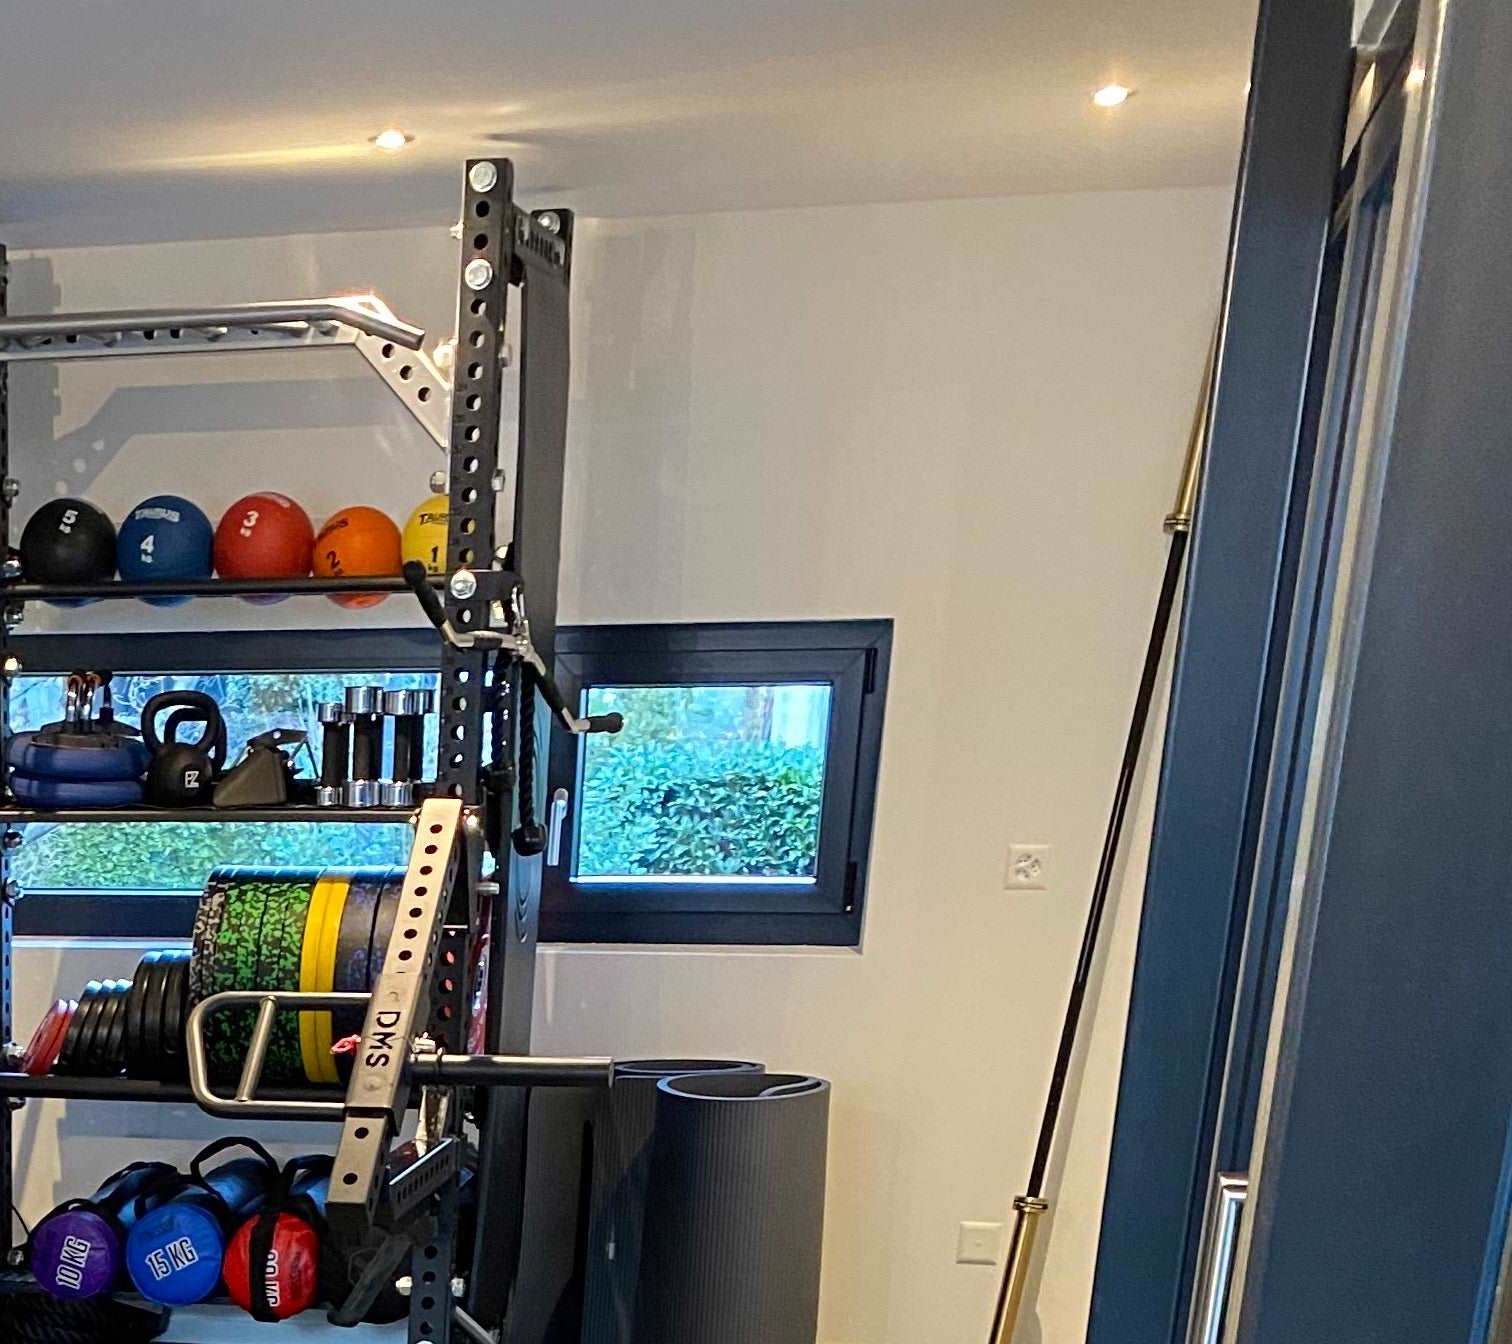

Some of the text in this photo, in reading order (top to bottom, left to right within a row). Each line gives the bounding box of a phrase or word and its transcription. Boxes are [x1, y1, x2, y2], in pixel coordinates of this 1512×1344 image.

[62, 509, 78, 524] 5
[243, 510, 259, 527] 3
[140, 535, 154, 553] 4
[327, 550, 340, 568] 2
[431, 546, 439, 563] 1
[365, 1011, 401, 1067] DMS
[56, 1235, 90, 1290] 10 KG
[145, 1237, 198, 1280] 15 KG
